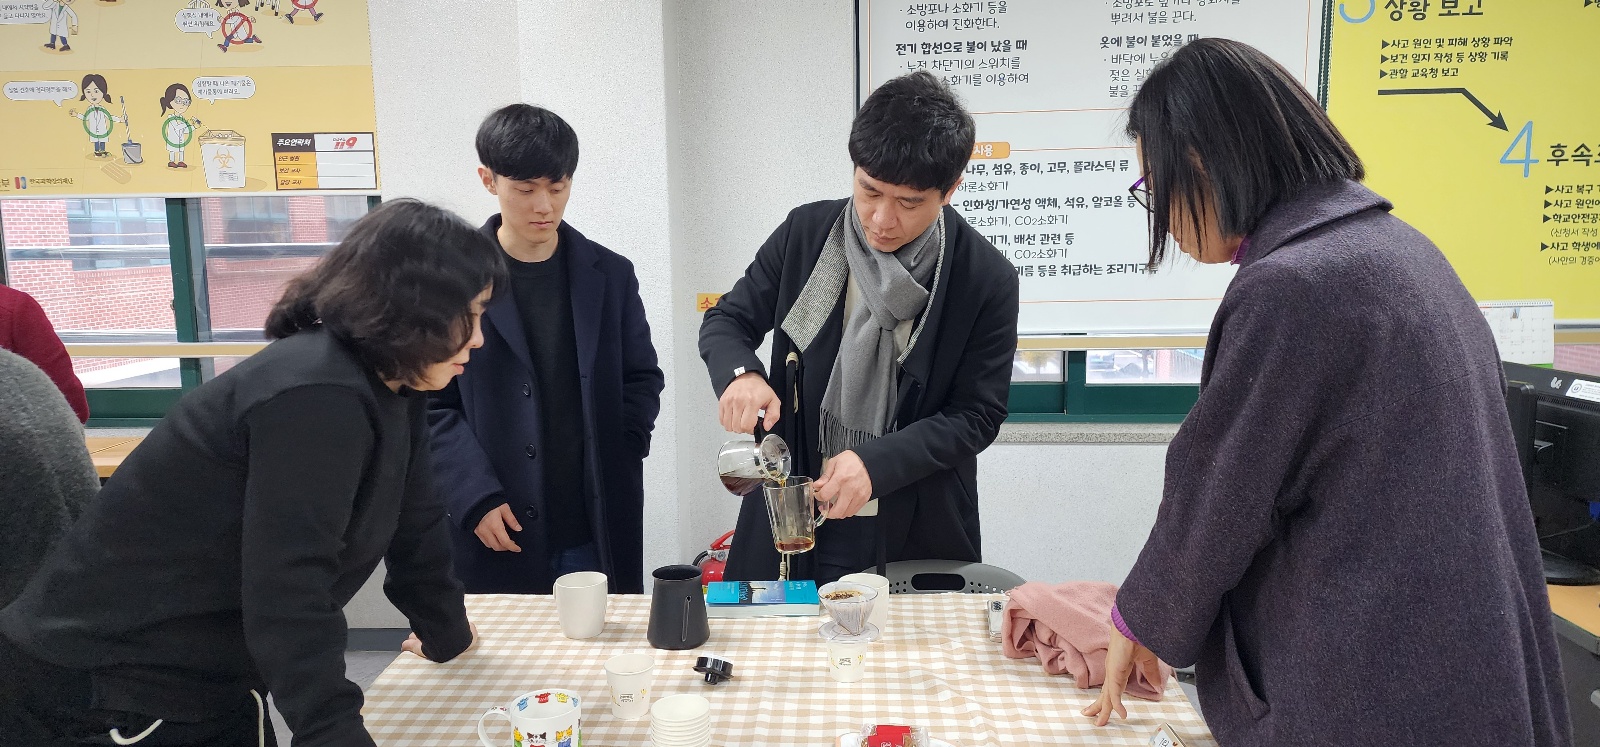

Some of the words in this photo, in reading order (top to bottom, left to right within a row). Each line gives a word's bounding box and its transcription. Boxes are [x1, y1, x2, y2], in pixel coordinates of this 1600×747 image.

[906, 3, 949, 17] 소방포나
[952, 2, 983, 14] 소화기
[988, 0, 1008, 15] 등을
[1384, 0, 1431, 21] 상황
[1438, 0, 1484, 17] 보고
[905, 18, 949, 33] 이용하여
[952, 17, 1001, 31] 진화한다.
[1110, 12, 1144, 26] 뿌려서
[1148, 10, 1168, 25] 불을
[1171, 10, 1197, 24] 끈다.
[895, 43, 917, 56] 전기
[920, 41, 963, 55] 합선으로
[966, 40, 987, 54] 불이
[990, 39, 1012, 53] 났을
[1015, 39, 1028, 51] 때
[1100, 35, 1122, 50] 옷에
[1125, 34, 1148, 49] 불이
[1150, 33, 1183, 48] 붙었을
[1390, 39, 1409, 50] 사고
[1412, 38, 1432, 49] 원인
[1435, 38, 1445, 49] 및
[1447, 37, 1468, 48] 피해
[1470, 36, 1491, 49] 상황
[1493, 36, 1514, 47] 파악
[931, 58, 975, 72] 차단기의
[978, 57, 1021, 70] 스위치를
[1111, 52, 1146, 66] 바닥에
[1390, 53, 1408, 65] 보건
[1411, 52, 1431, 65] 일지
[1433, 52, 1454, 64] 작성
[1455, 51, 1465, 63] 등
[1467, 51, 1489, 63] 상황
[1491, 50, 1509, 62] 기록
[985, 72, 1030, 87] 이용하여
[1109, 68, 1131, 82] 젖은
[1388, 69, 1409, 80] 관할
[1411, 67, 1439, 79] 교육청
[1441, 67, 1460, 78] 보고
[1108, 84, 1129, 98] 불을
[973, 143, 994, 158] 사용
[1499, 120, 1540, 178] 4
[1546, 142, 1600, 168] 후속
[965, 163, 989, 177] 나무,
[991, 163, 1017, 176] 섬유,
[1019, 162, 1045, 176] 종이,
[1046, 161, 1070, 174] 고무,
[1073, 160, 1116, 174] 플라스틱
[1119, 160, 1129, 172] 류
[1554, 184, 1573, 194] 사고
[1576, 184, 1594, 195] 복구
[962, 198, 1032, 212] 인화성/가연성
[1034, 197, 1061, 211] 액체,
[1064, 196, 1089, 210] 석유,
[1091, 195, 1124, 209] 알코올
[1127, 195, 1138, 208] 등
[1553, 199, 1572, 209] 사고
[964, 215, 1011, 228] 론소화기,
[1552, 213, 1600, 224] 학교안전공
[1013, 233, 1036, 246] 배선
[1039, 232, 1061, 245] 관련
[1064, 232, 1075, 246] 등
[1550, 227, 1579, 238] (신청서
[1581, 227, 1598, 238] 작성
[1549, 242, 1569, 252] 사고
[1037, 264, 1058, 277] 등을
[1060, 263, 1104, 276] 취급하는
